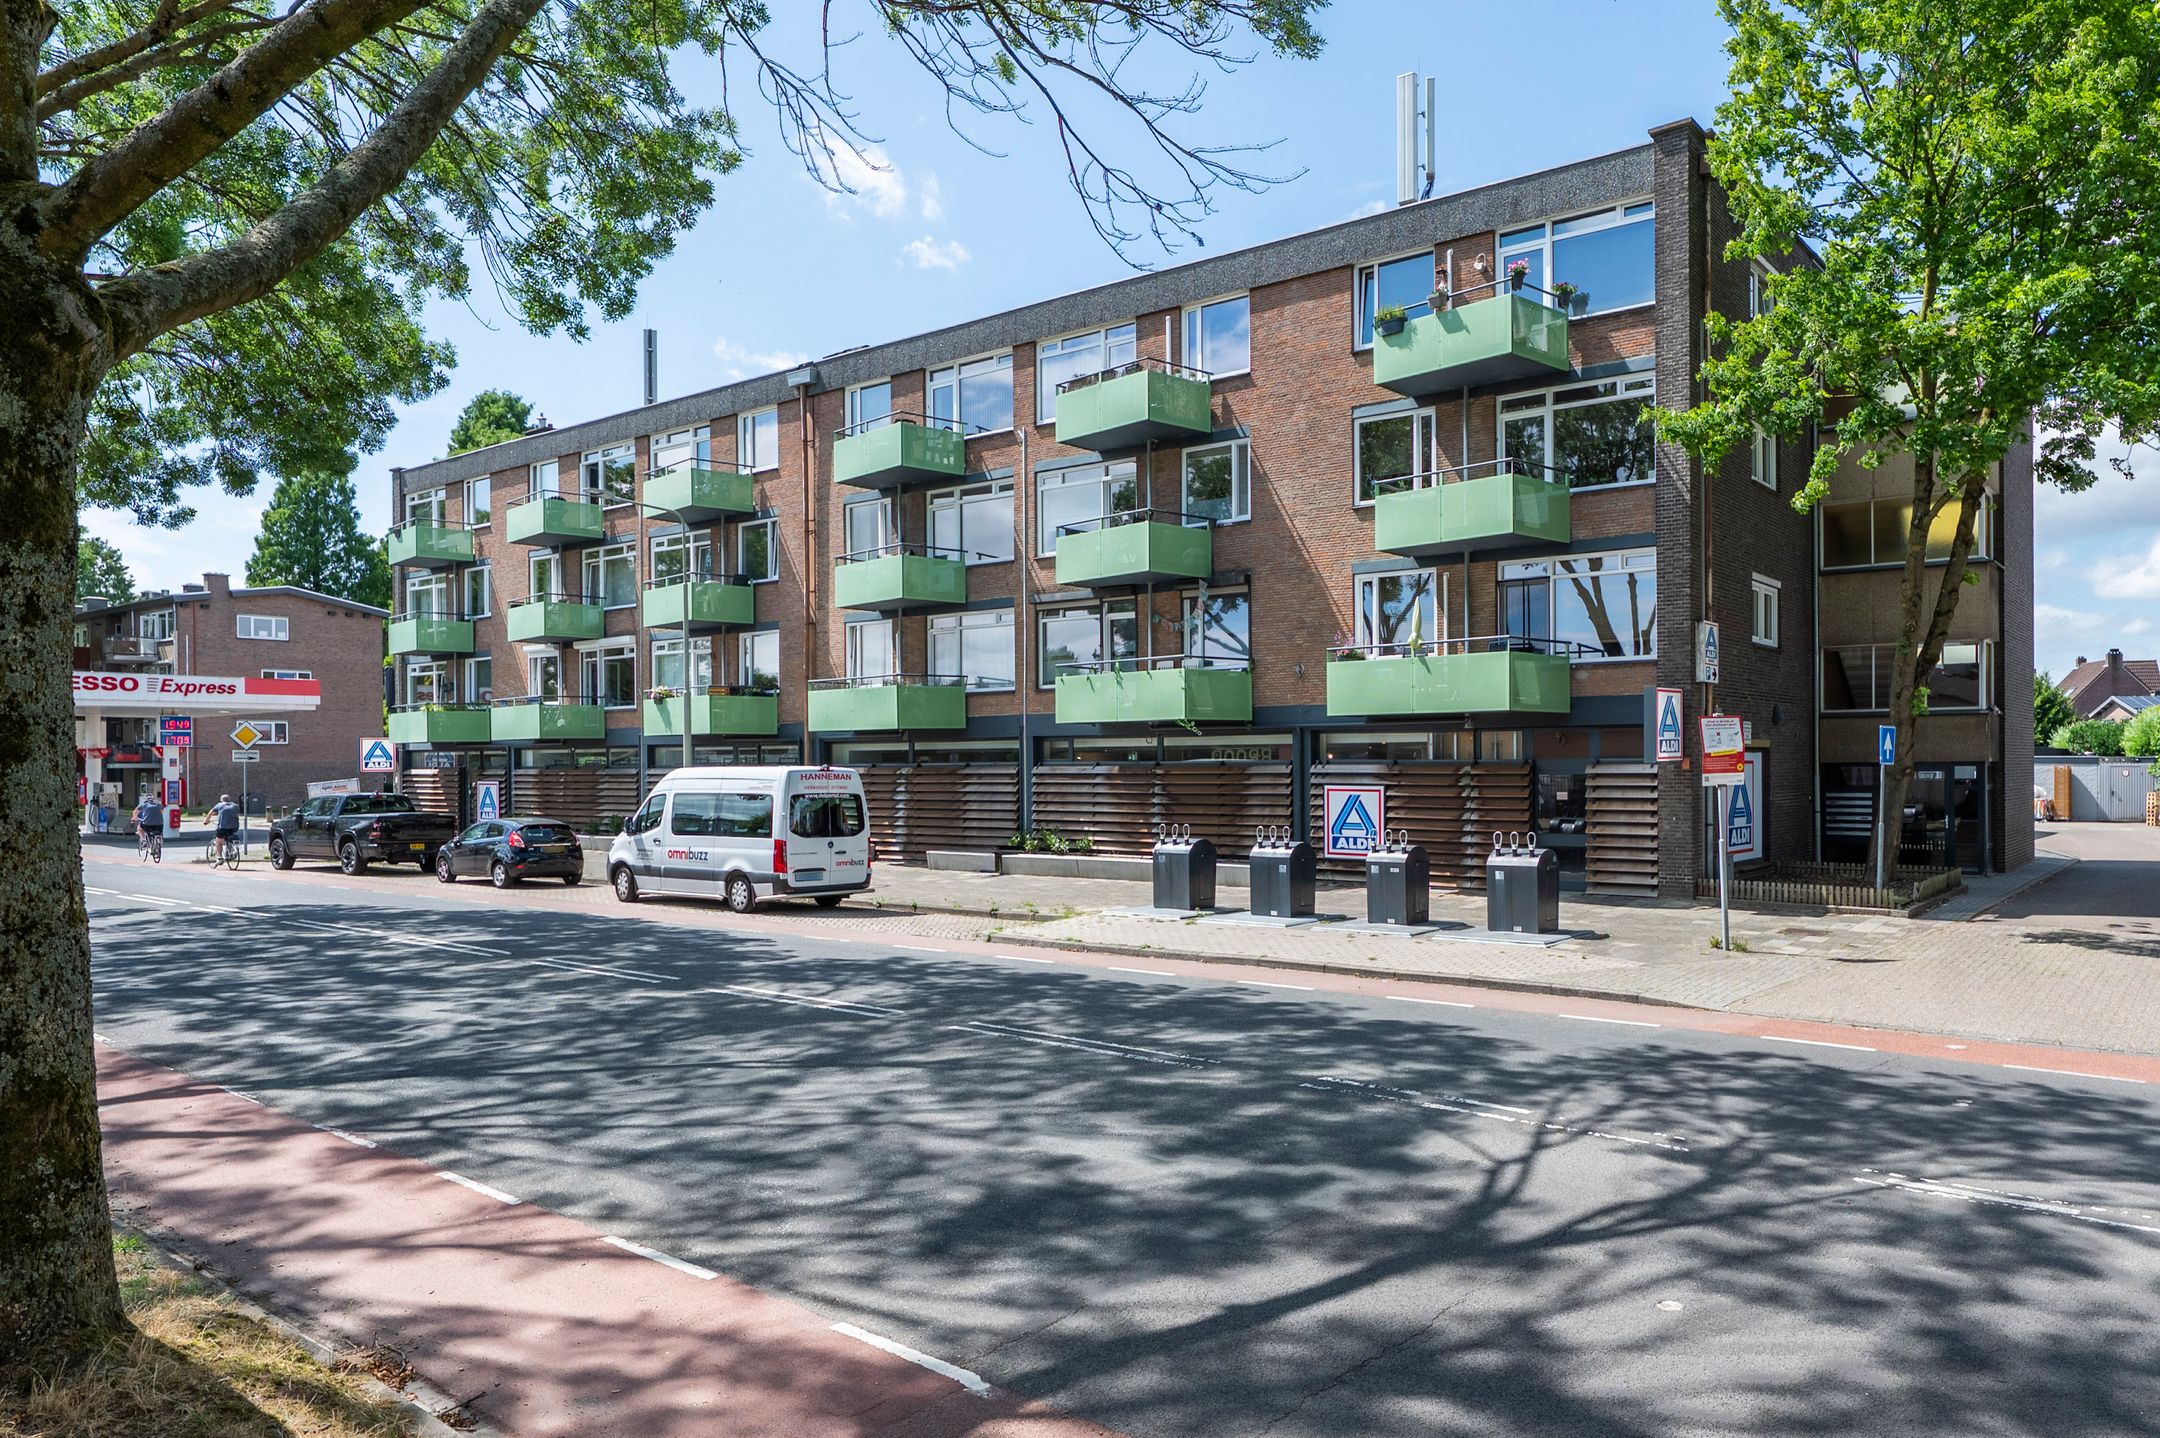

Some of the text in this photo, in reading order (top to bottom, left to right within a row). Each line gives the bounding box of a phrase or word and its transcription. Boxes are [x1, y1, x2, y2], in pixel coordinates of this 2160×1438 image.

[159, 678, 237, 696] Express
[1660, 740, 1679, 752] ALDI
[800, 772, 852, 781] HANNEMAN
[481, 812, 495, 820] ALDI
[1730, 827, 1750, 845] ALDI
[667, 846, 709, 861] omnibuzz
[835, 858, 865, 867] omnibuzz
